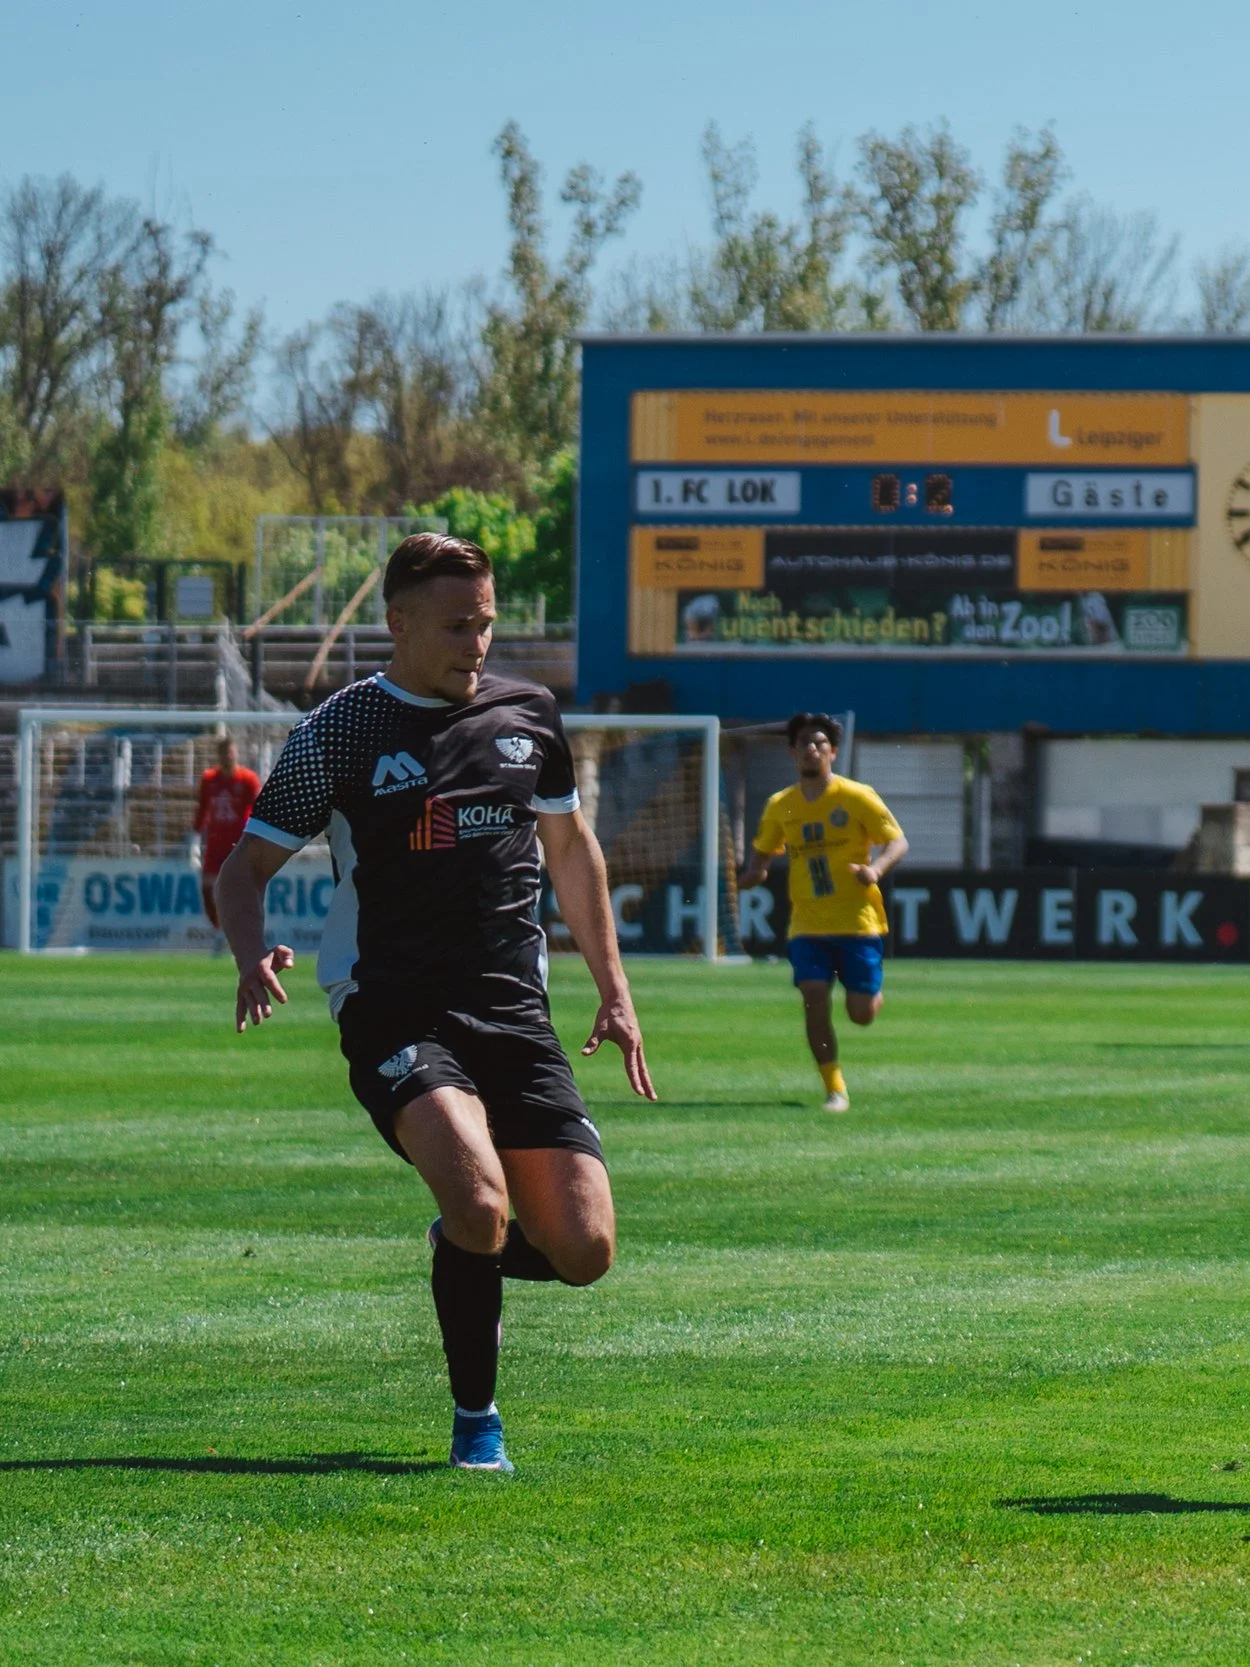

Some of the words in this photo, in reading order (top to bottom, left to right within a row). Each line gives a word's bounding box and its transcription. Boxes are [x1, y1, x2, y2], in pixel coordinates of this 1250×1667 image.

[682, 478, 709, 504] FC
[727, 478, 777, 504] LOK
[1051, 478, 1170, 508] Gäste
[720, 605, 947, 642] unentschieden?
[1001, 600, 1072, 644] Zoo!
[458, 805, 514, 827] KOHA
[84, 871, 204, 915] OSWA
[266, 874, 337, 917] RIC
